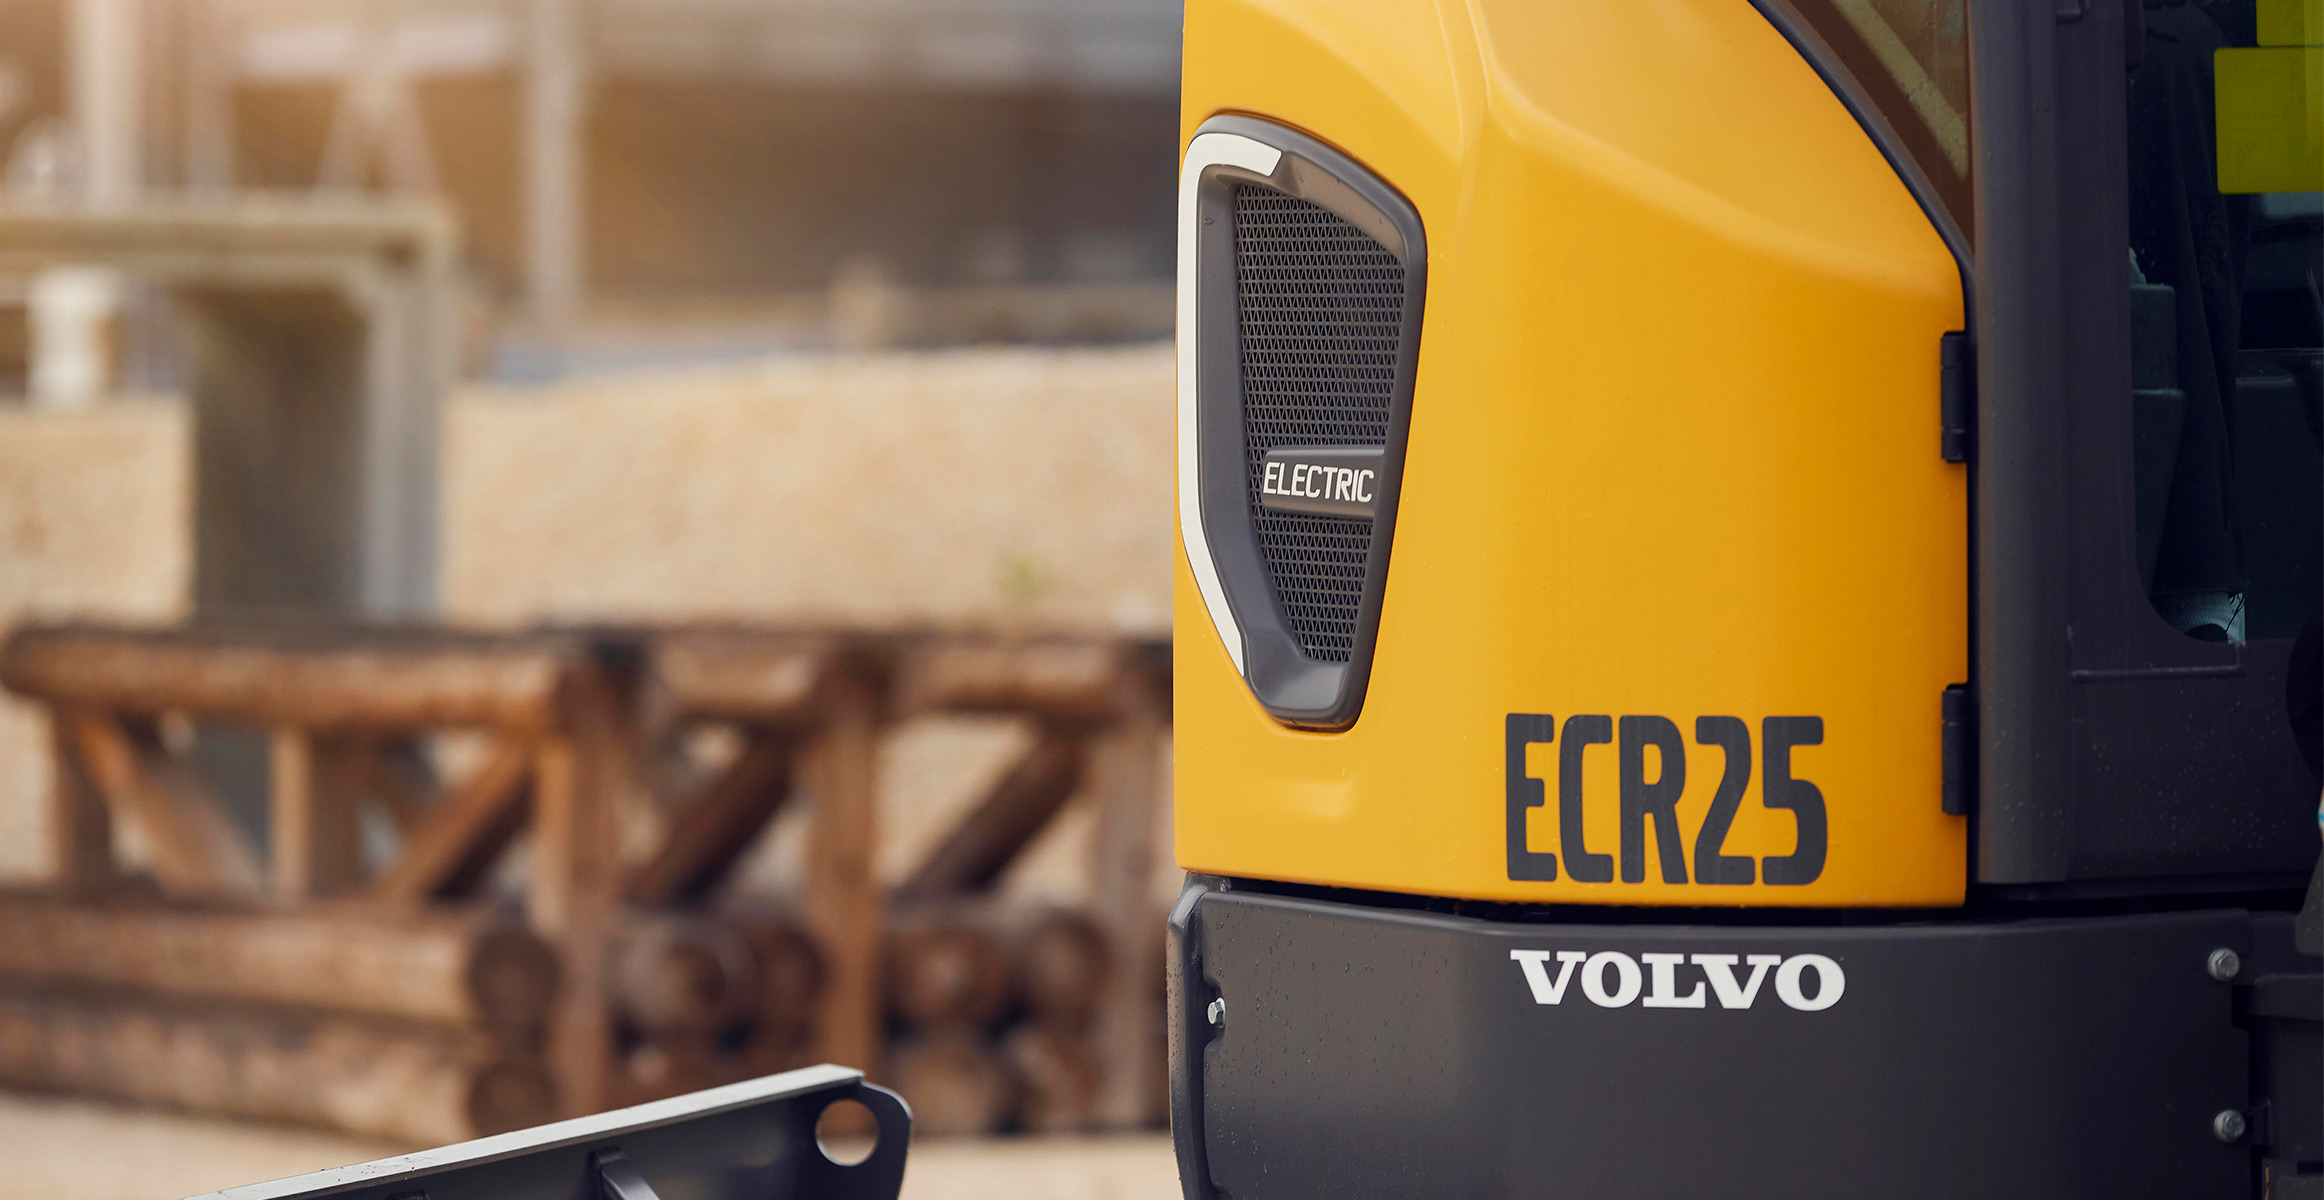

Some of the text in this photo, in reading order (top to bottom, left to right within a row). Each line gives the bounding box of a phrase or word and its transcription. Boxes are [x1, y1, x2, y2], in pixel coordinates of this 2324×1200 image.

[1263, 461, 1375, 503] ELECTRIC
[1505, 713, 1828, 886] ECR25
[1510, 949, 1846, 1011] VOLVO
